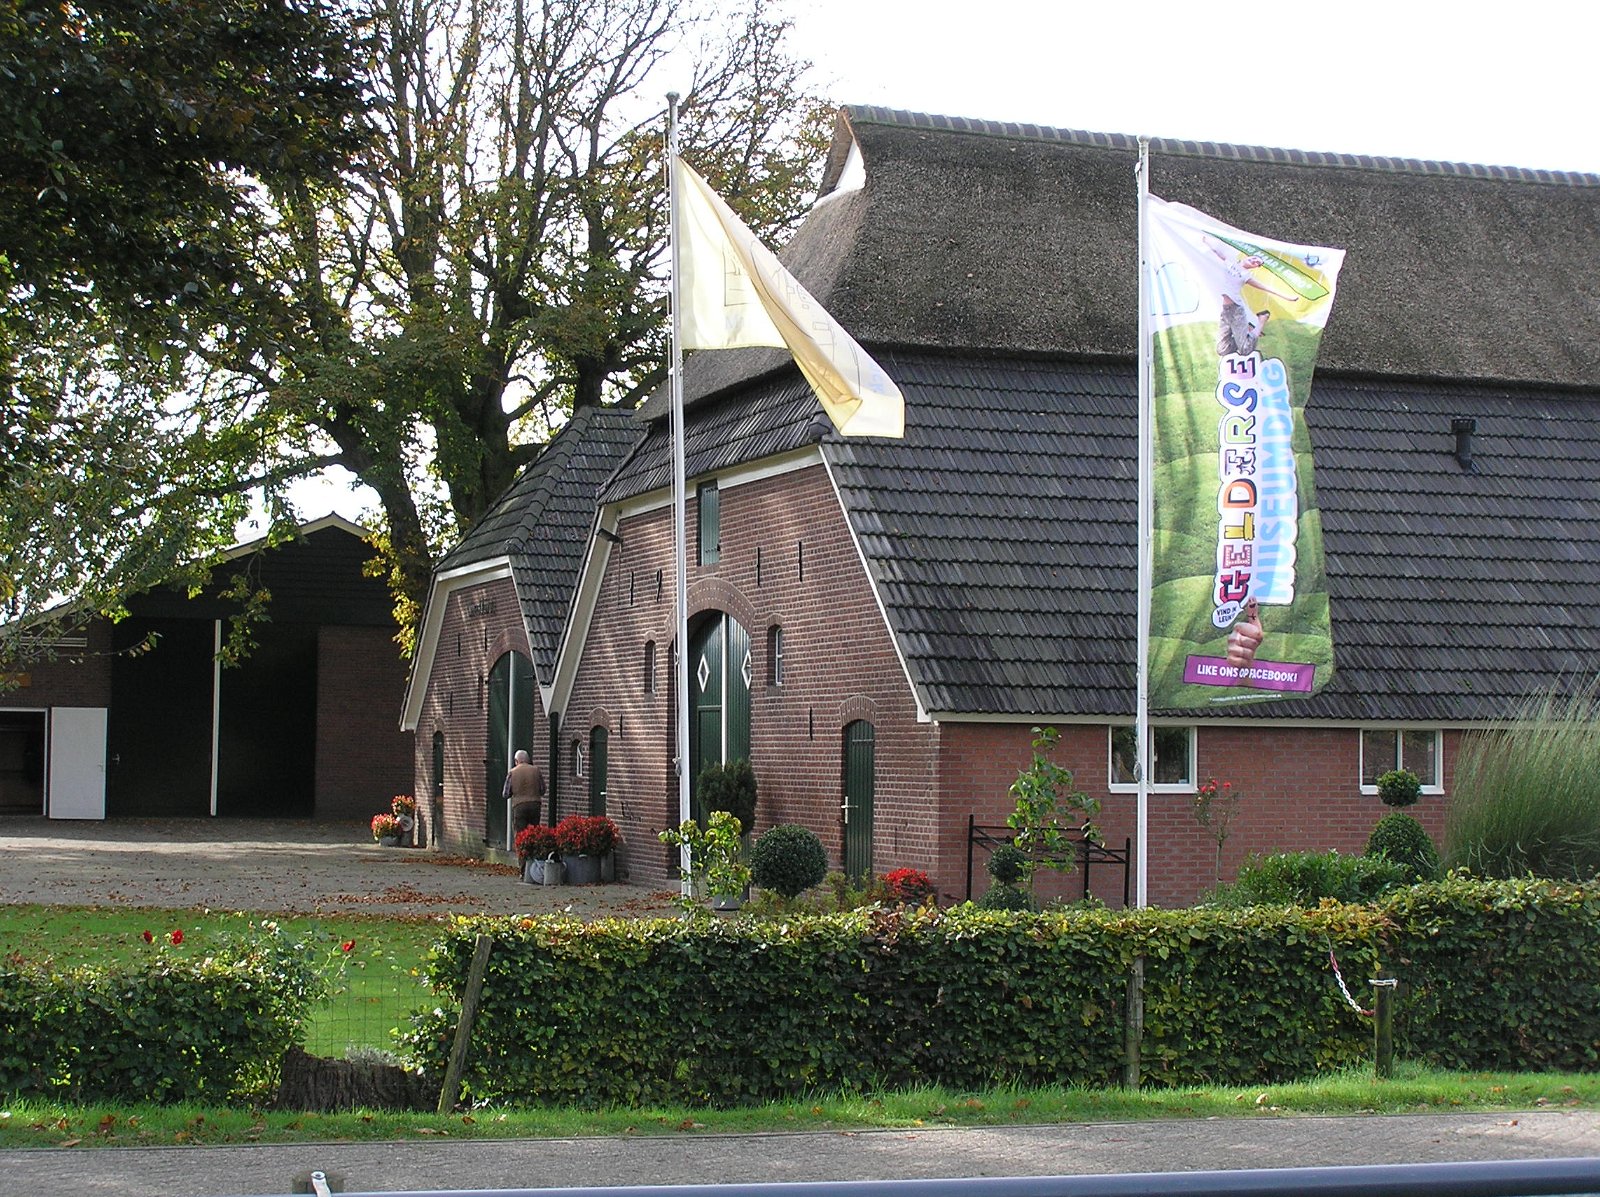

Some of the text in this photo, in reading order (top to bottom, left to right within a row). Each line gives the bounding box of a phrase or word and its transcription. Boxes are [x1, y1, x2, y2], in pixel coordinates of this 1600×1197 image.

[1219, 357, 1258, 603] GELDERSE
[1253, 363, 1295, 598] MUSEUMDAG
[1197, 664, 1298, 682] LIKE ONS OP FACEBOOK!
[1216, 608, 1231, 616] VIND
